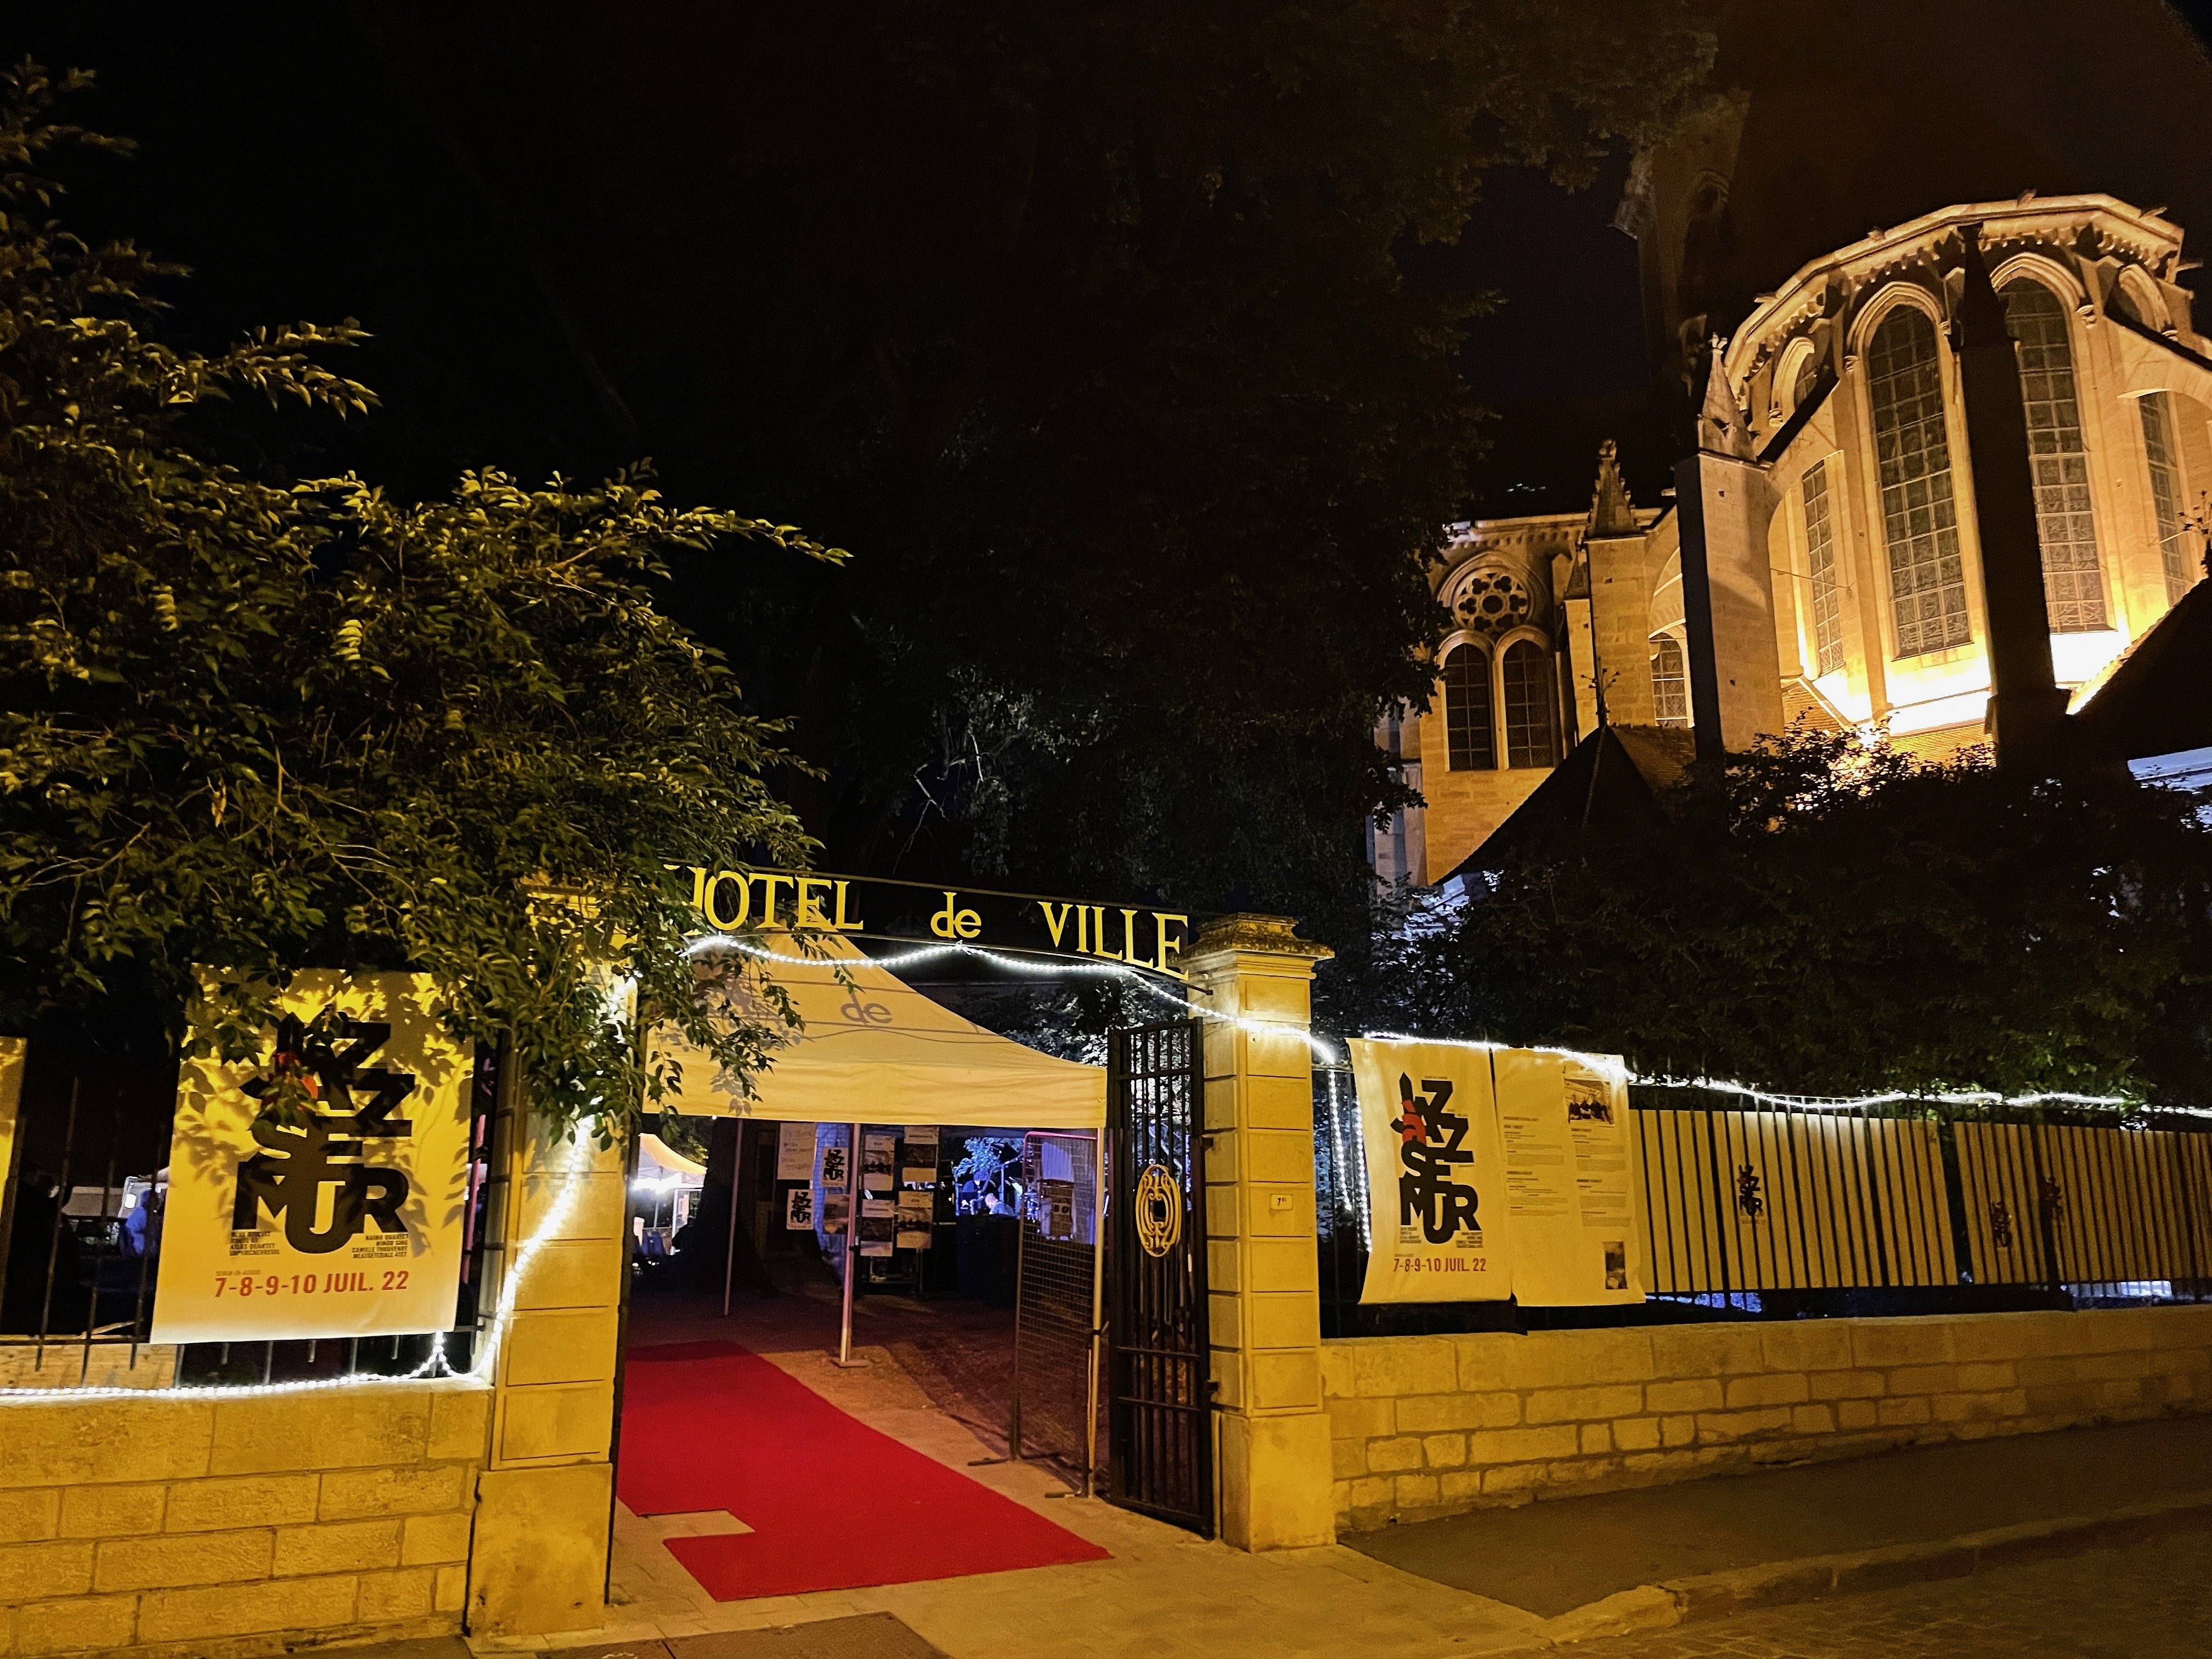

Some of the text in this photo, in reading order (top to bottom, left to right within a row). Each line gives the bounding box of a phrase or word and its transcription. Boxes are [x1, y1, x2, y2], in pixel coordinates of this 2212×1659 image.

[930, 891, 981, 938] de
[1037, 901, 1189, 981] VILLE
[1393, 1258, 1441, 1272] 7-8-9-10
[1472, 1257, 1486, 1272] 22
[215, 1270, 409, 1297] 7-8-9-10 JUIL. 22
